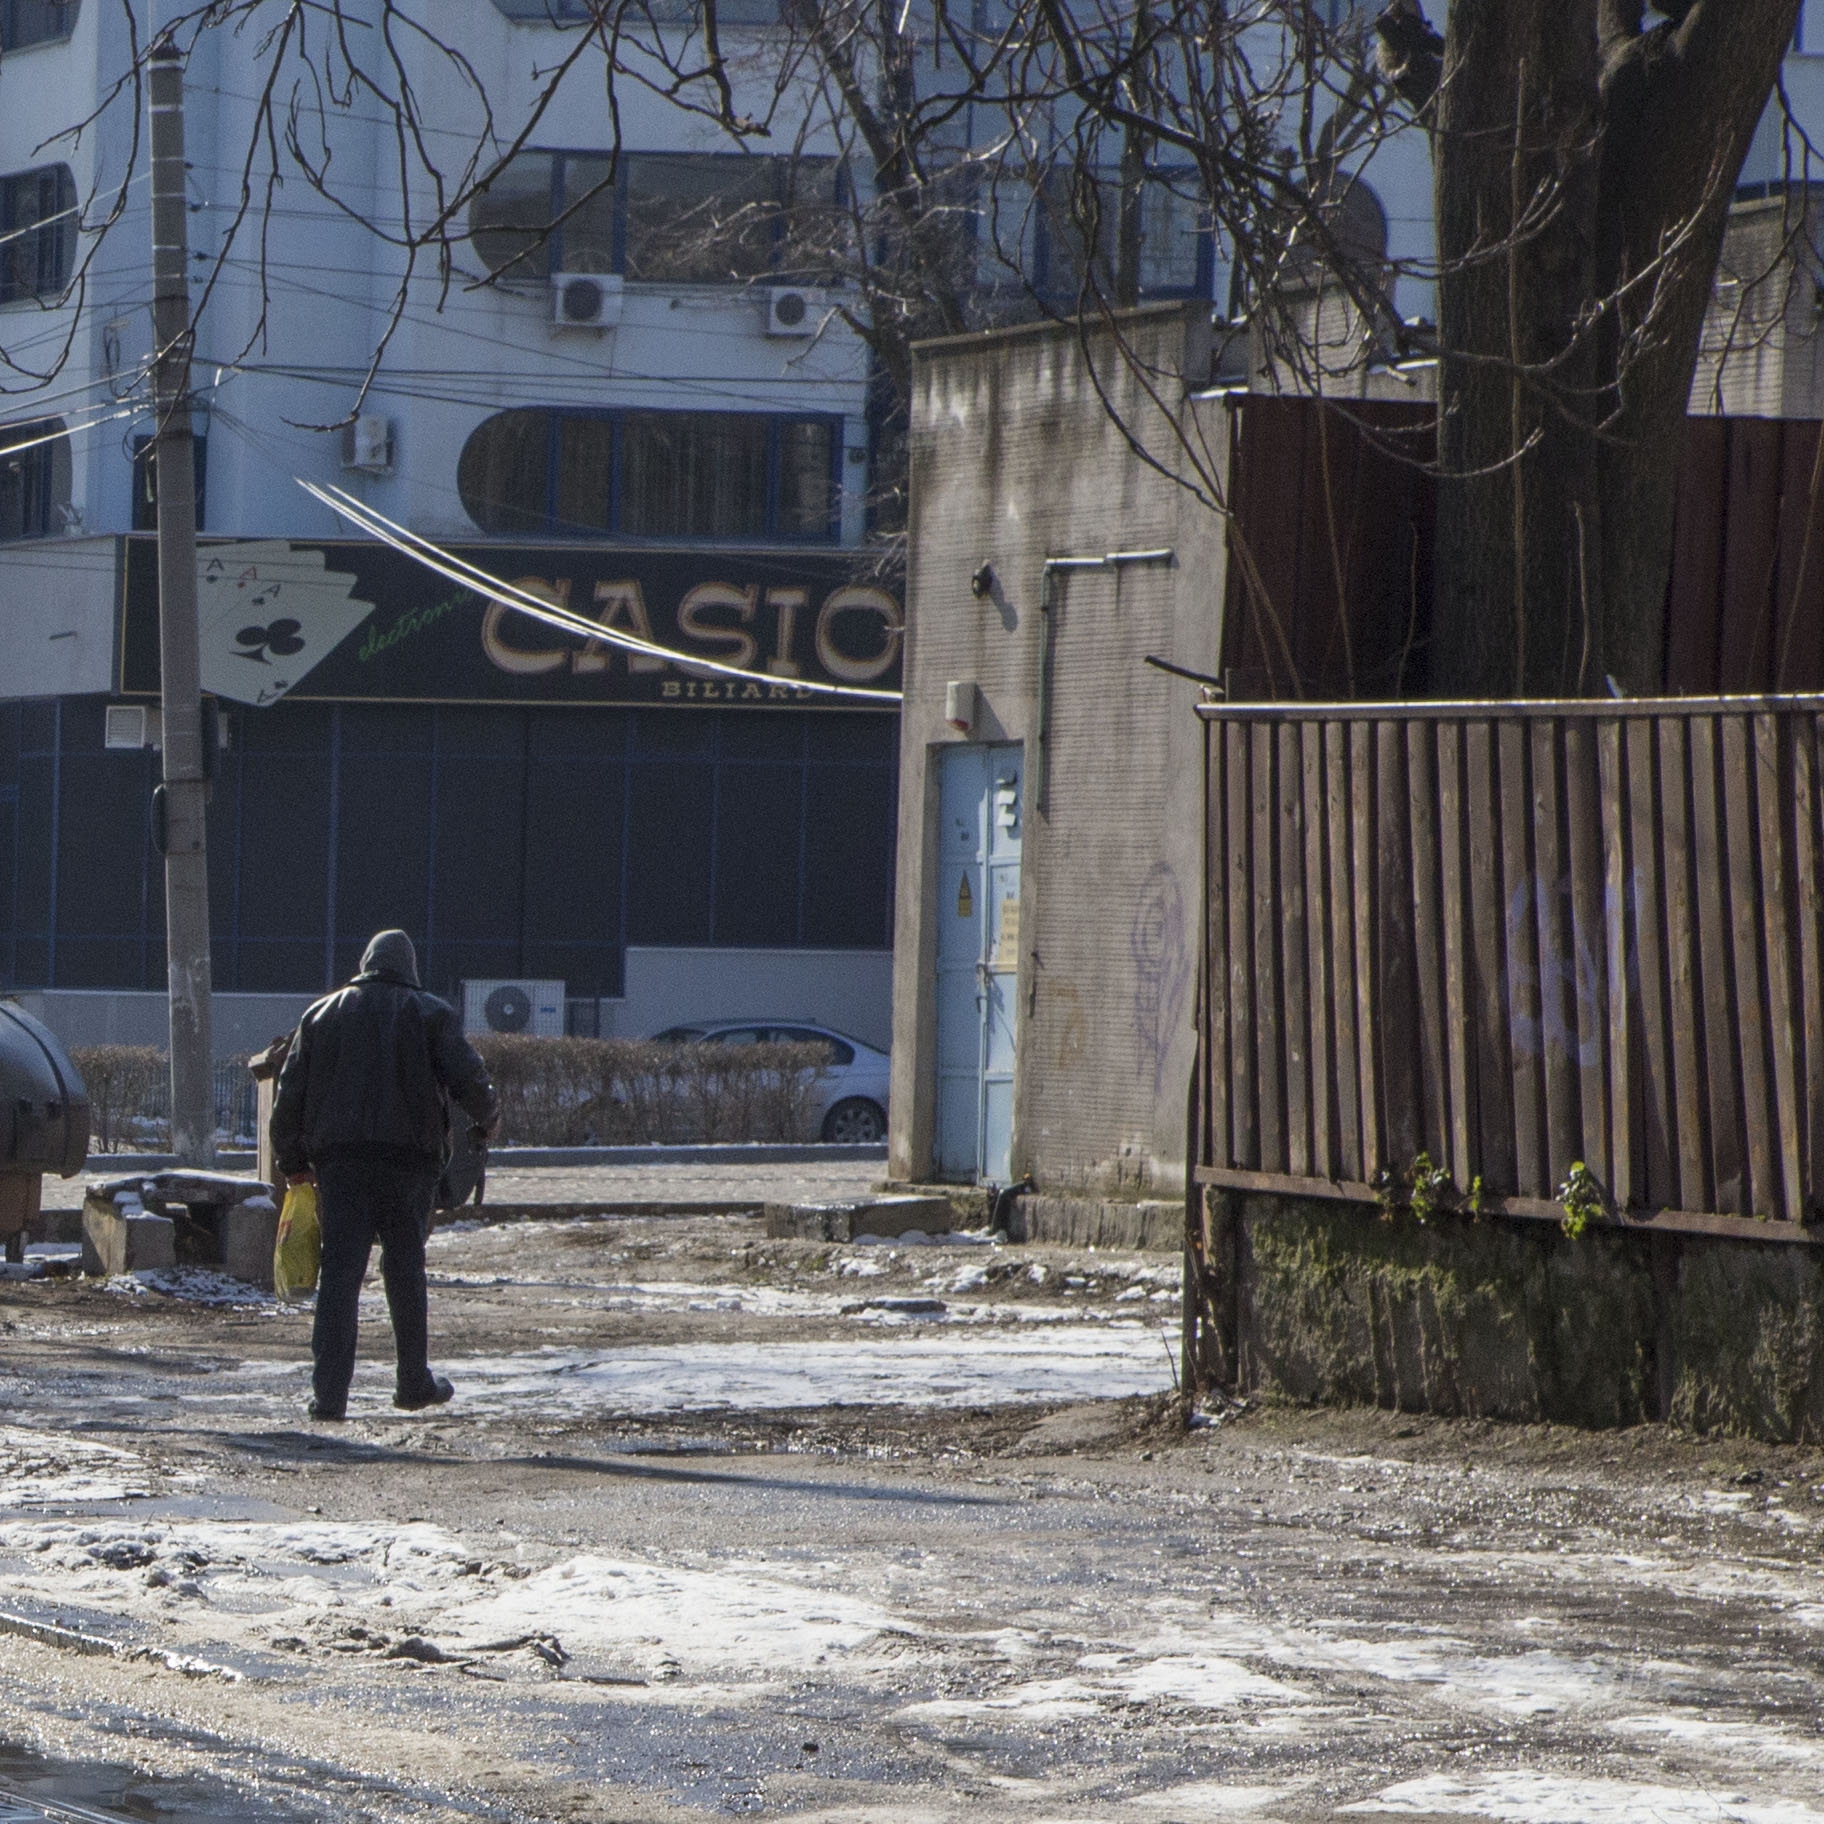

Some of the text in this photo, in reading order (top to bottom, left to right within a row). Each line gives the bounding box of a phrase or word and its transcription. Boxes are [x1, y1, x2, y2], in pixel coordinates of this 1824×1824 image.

[206, 557, 224, 572] A
[239, 566, 258, 581] A
[261, 583, 282, 599] A
[481, 574, 904, 680] CASIO
